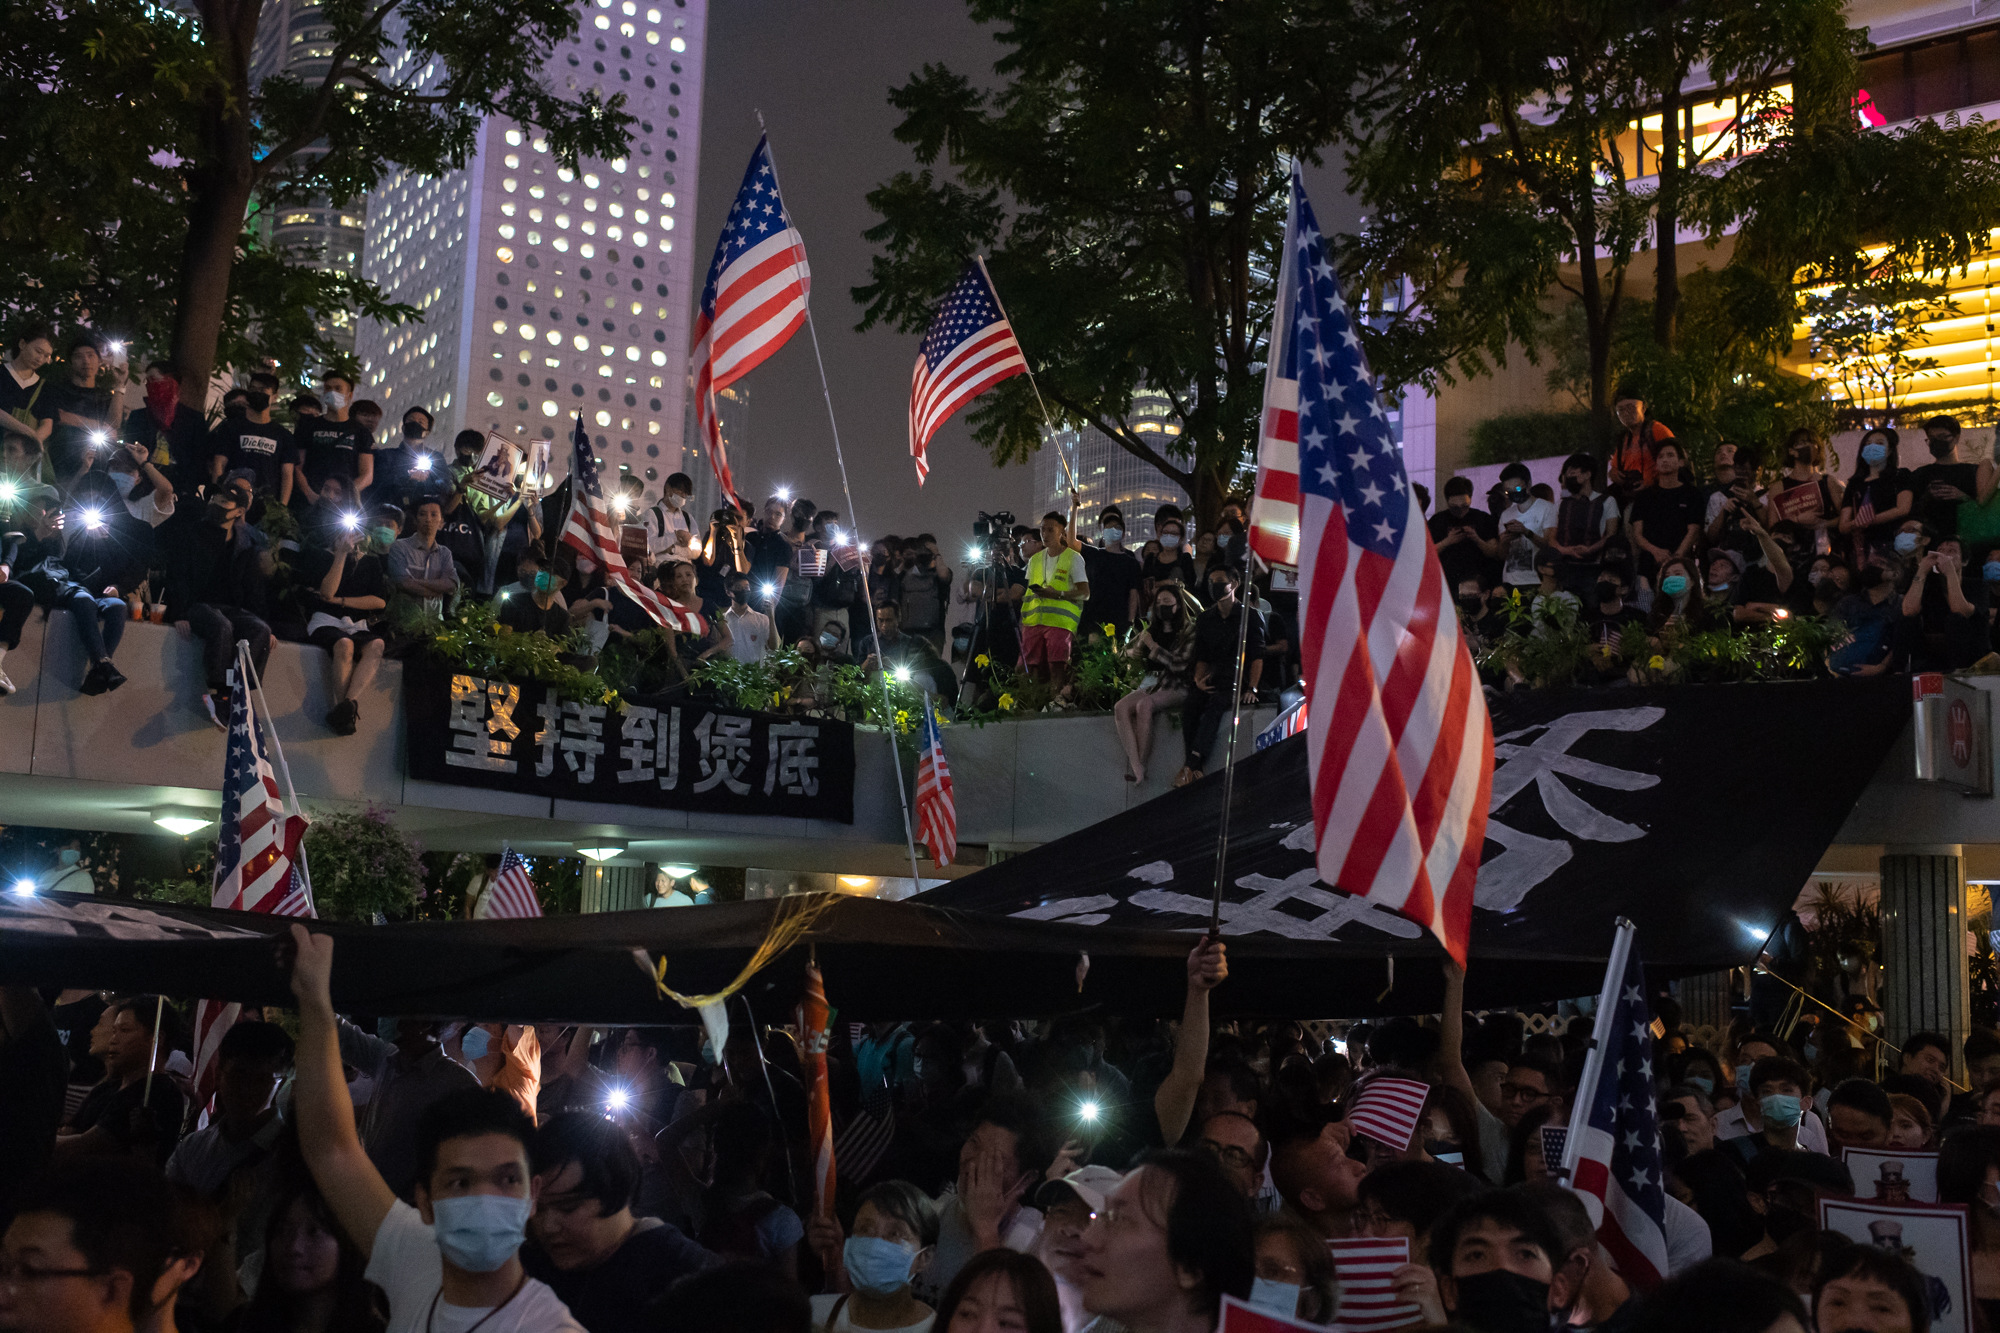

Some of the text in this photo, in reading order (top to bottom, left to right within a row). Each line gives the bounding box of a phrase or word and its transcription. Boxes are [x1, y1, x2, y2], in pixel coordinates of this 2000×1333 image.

[241, 437, 276, 451] Dickies
[1801, 494, 1816, 502] YOU
[443, 521, 473, 535] .P.C.
[445, 673, 820, 797] 堅持到煲底
